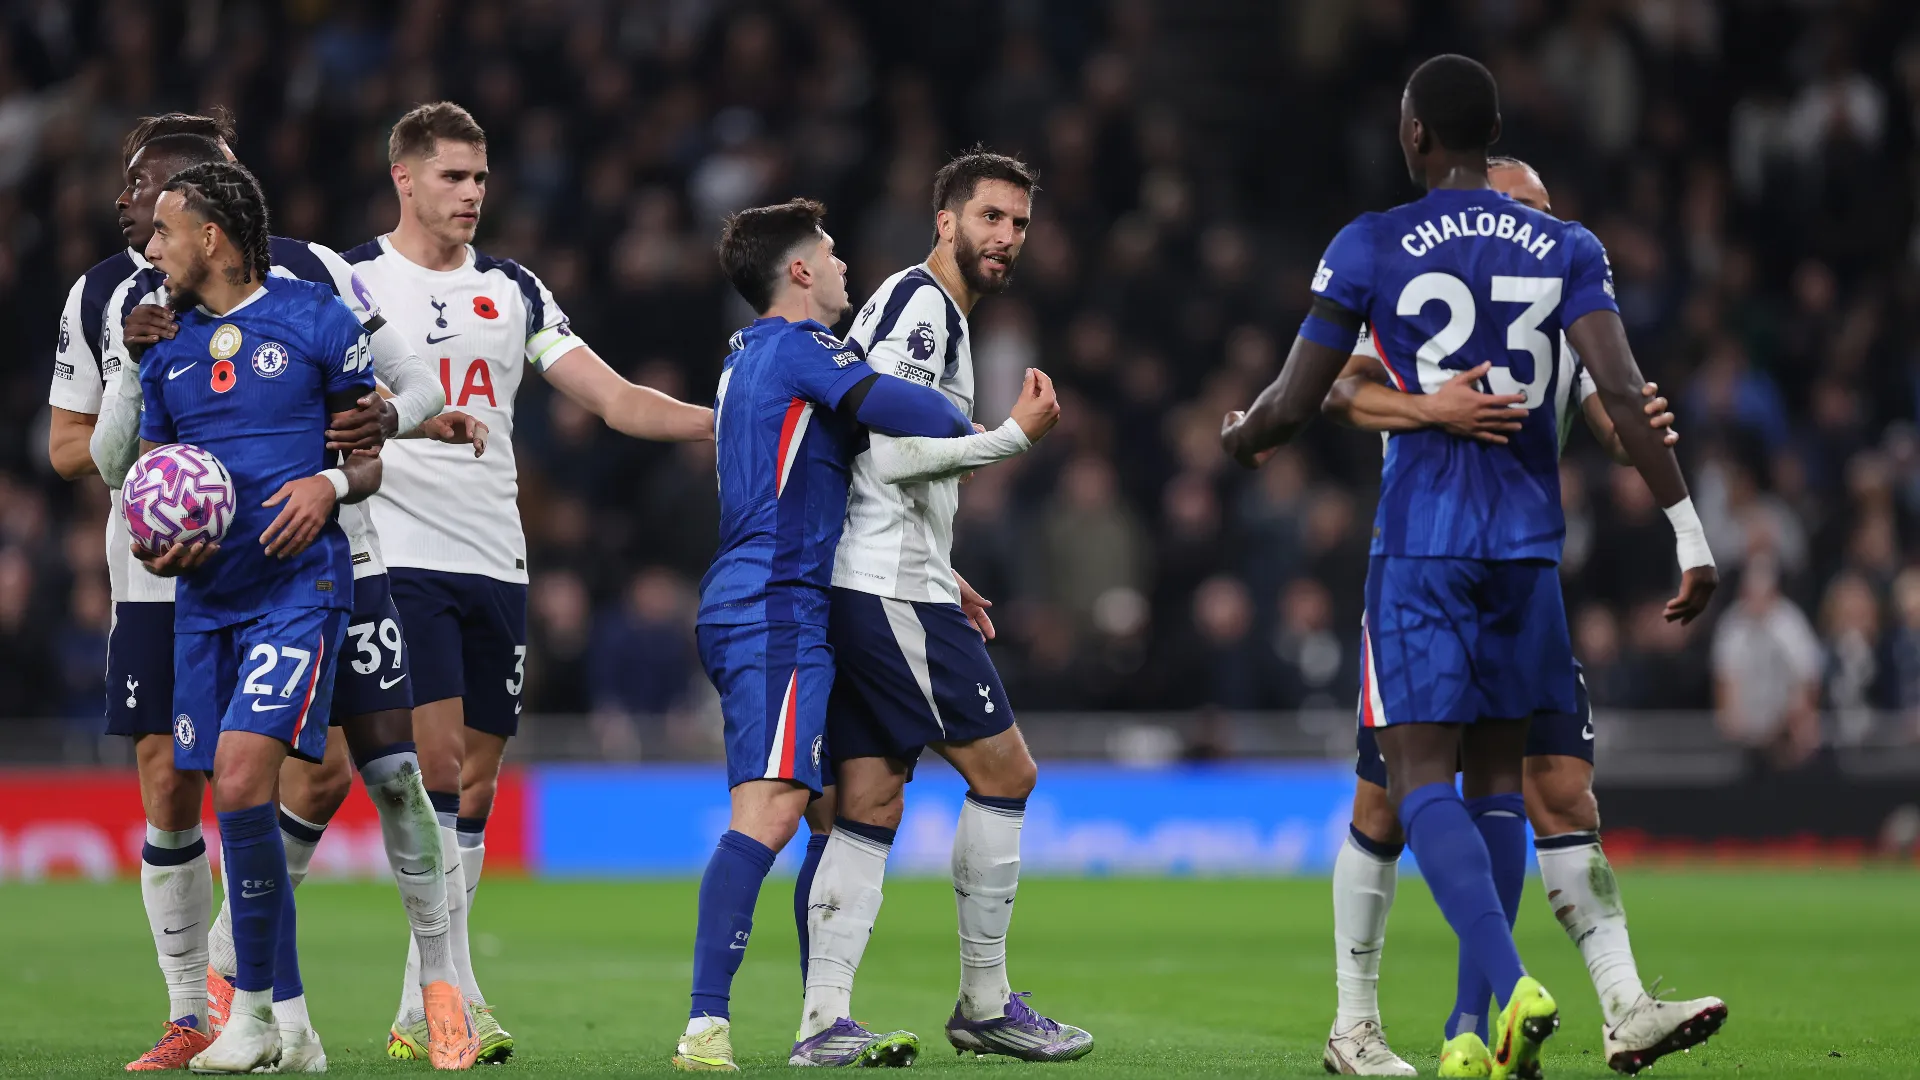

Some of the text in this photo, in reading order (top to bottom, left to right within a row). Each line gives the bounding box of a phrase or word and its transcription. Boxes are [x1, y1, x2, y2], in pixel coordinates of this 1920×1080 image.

[1401, 212, 1556, 260] CHALOBAH
[1396, 272, 1563, 410] 23
[439, 357, 497, 408] IA
[896, 360, 931, 380] No room
[243, 643, 311, 698] 27
[347, 617, 402, 675] 39
[506, 645, 526, 696] 3
[241, 879, 275, 889] CFC
